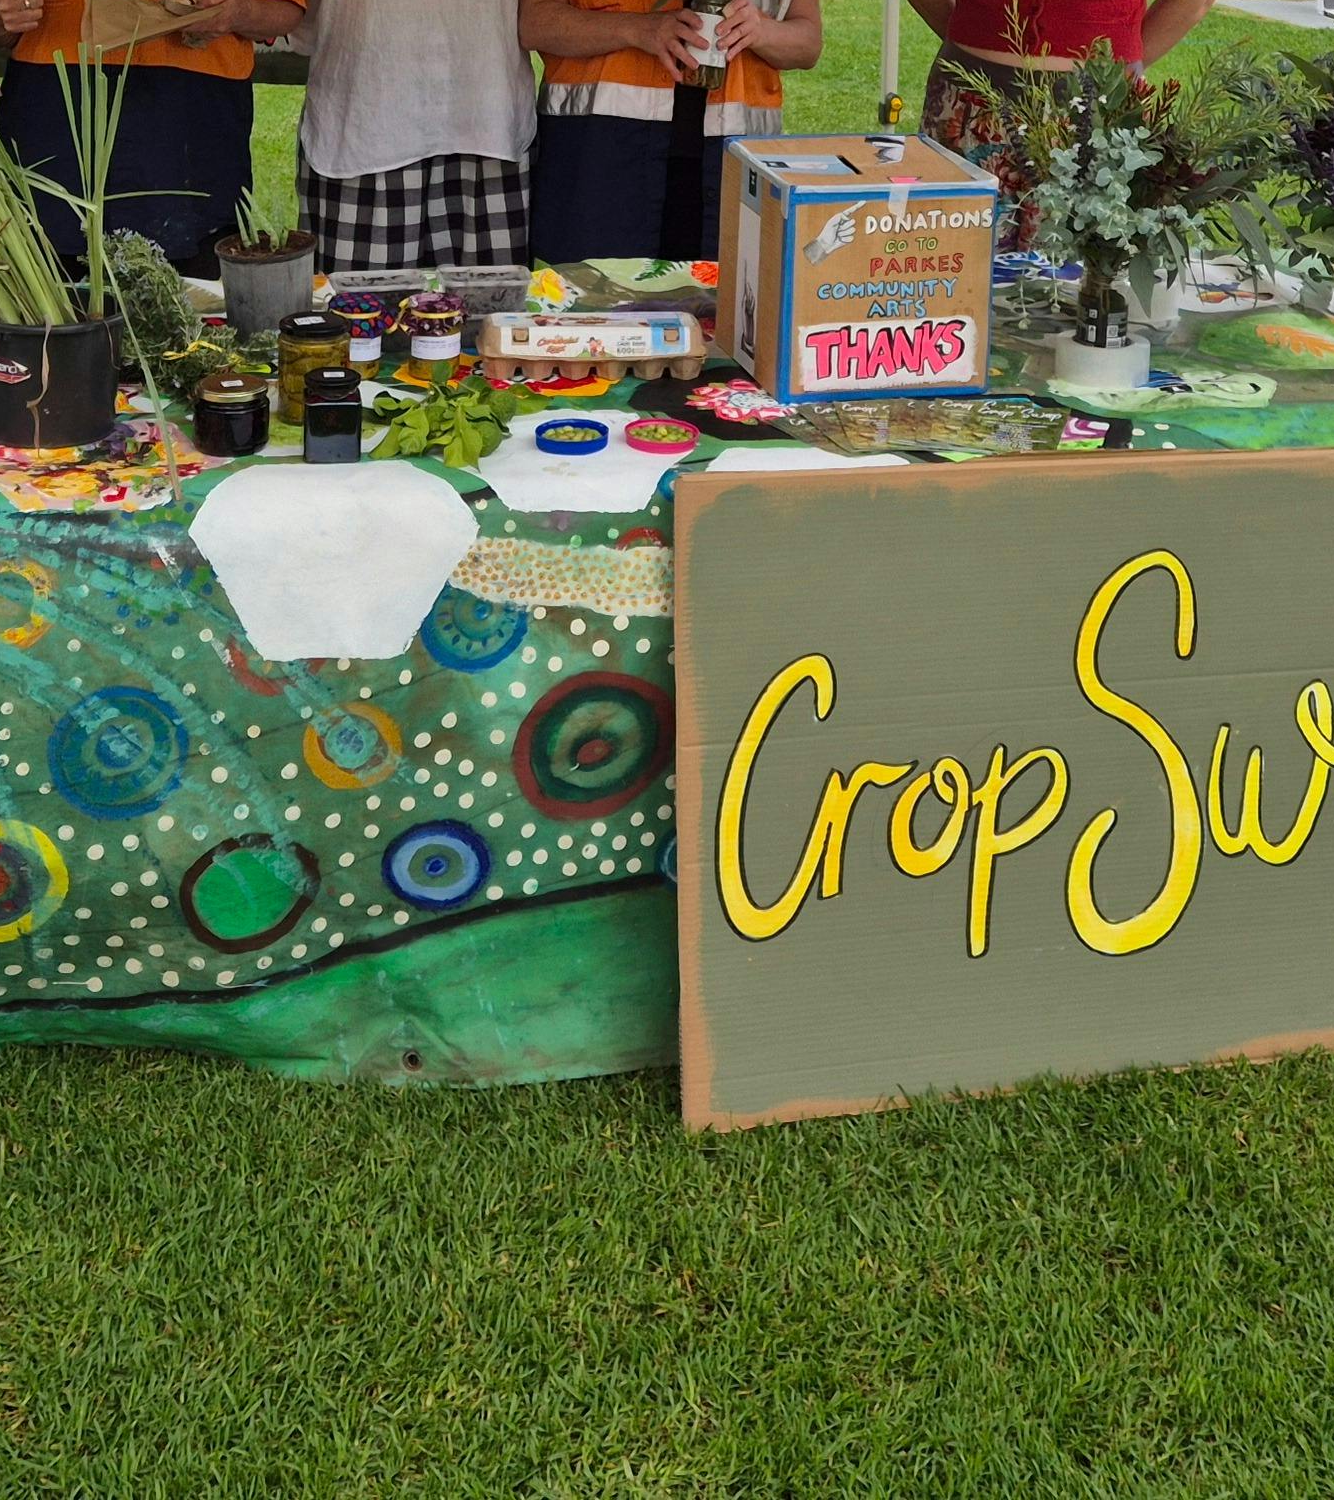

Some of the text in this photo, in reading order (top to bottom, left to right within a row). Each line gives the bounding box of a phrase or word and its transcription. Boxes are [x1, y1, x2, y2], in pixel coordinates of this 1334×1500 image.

[865, 209, 993, 234] DONATIONS
[884, 236, 938, 254] GO TO
[869, 253, 965, 277] PARKES
[817, 277, 958, 300] COMMUNITY
[867, 299, 927, 318] ARTS
[806, 320, 966, 380] THANKS
[715, 651, 1070, 958] Crop
